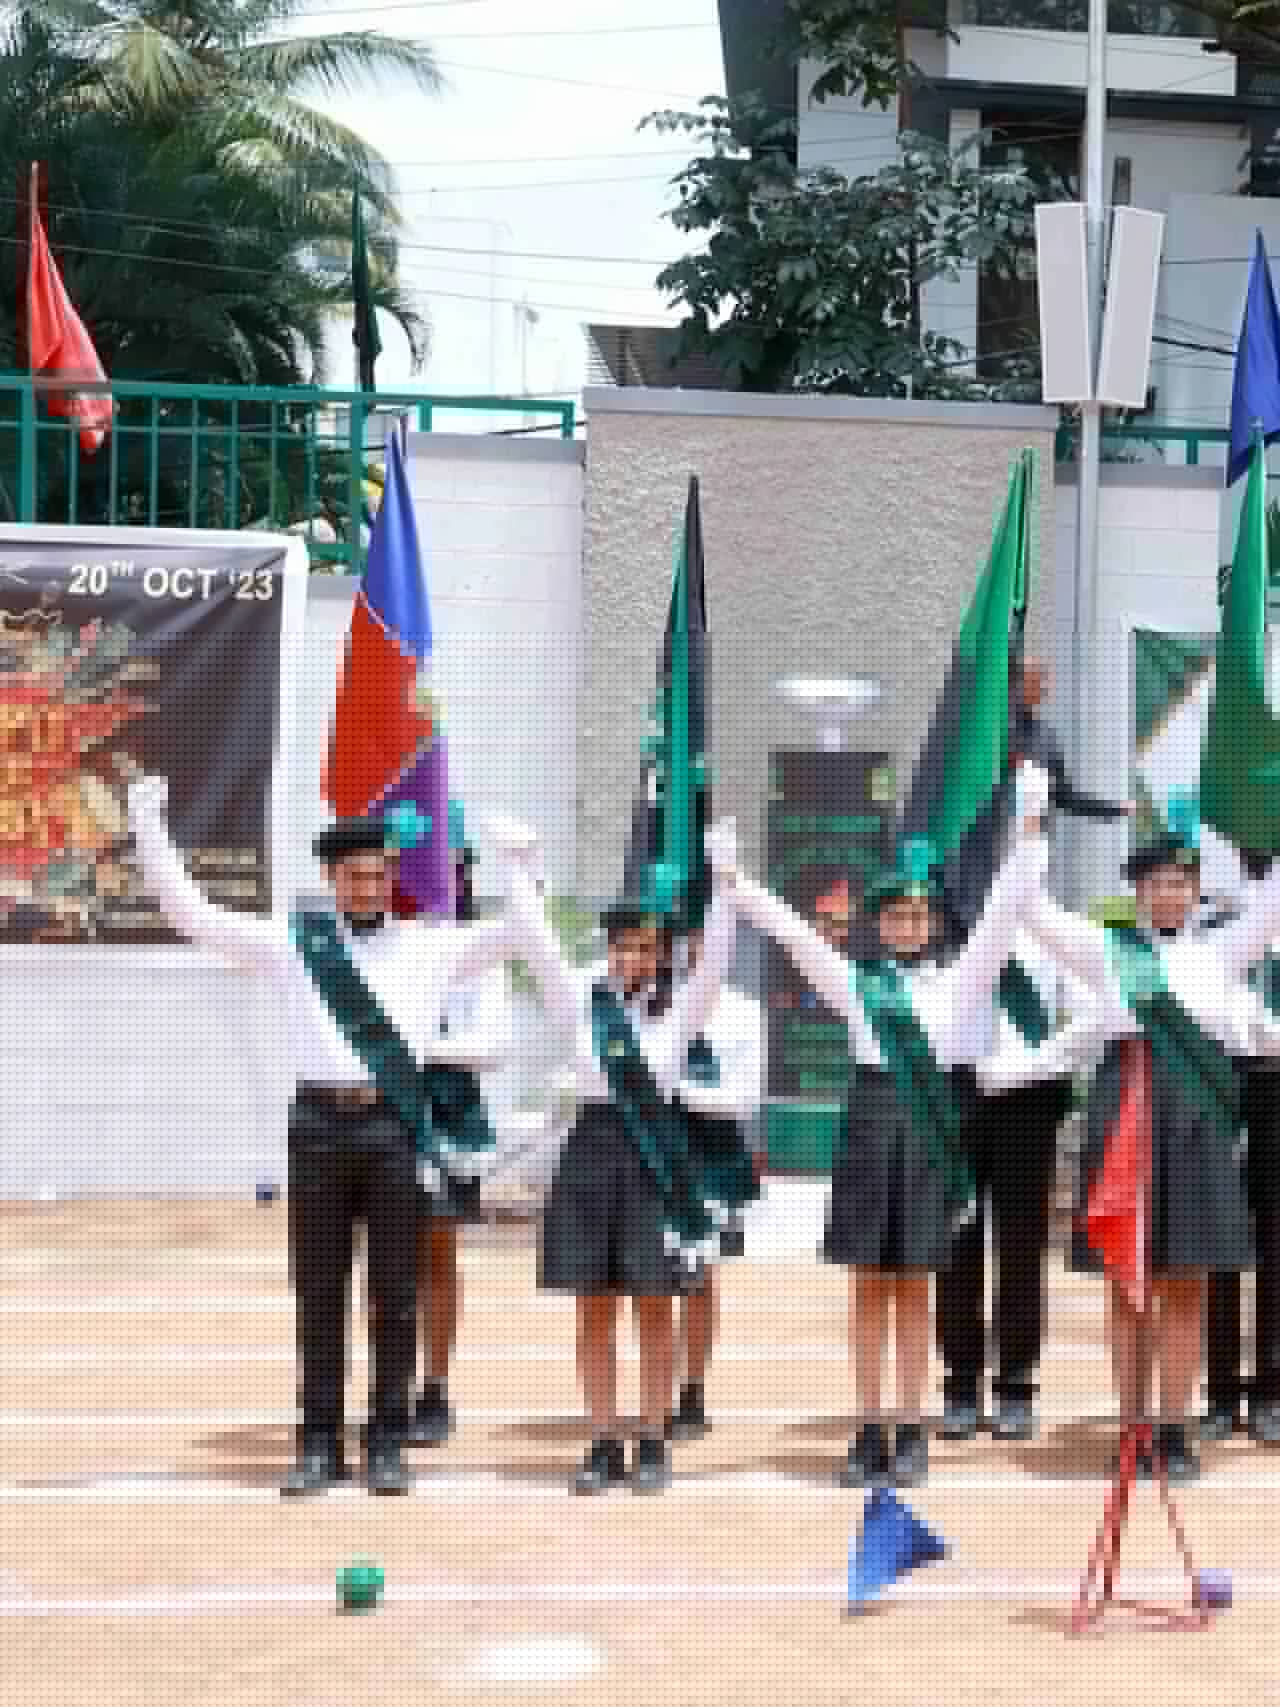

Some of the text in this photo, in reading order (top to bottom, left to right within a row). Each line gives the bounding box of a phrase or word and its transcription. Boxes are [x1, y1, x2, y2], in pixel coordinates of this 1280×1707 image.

[68, 561, 274, 601] 20TH OCT '23
